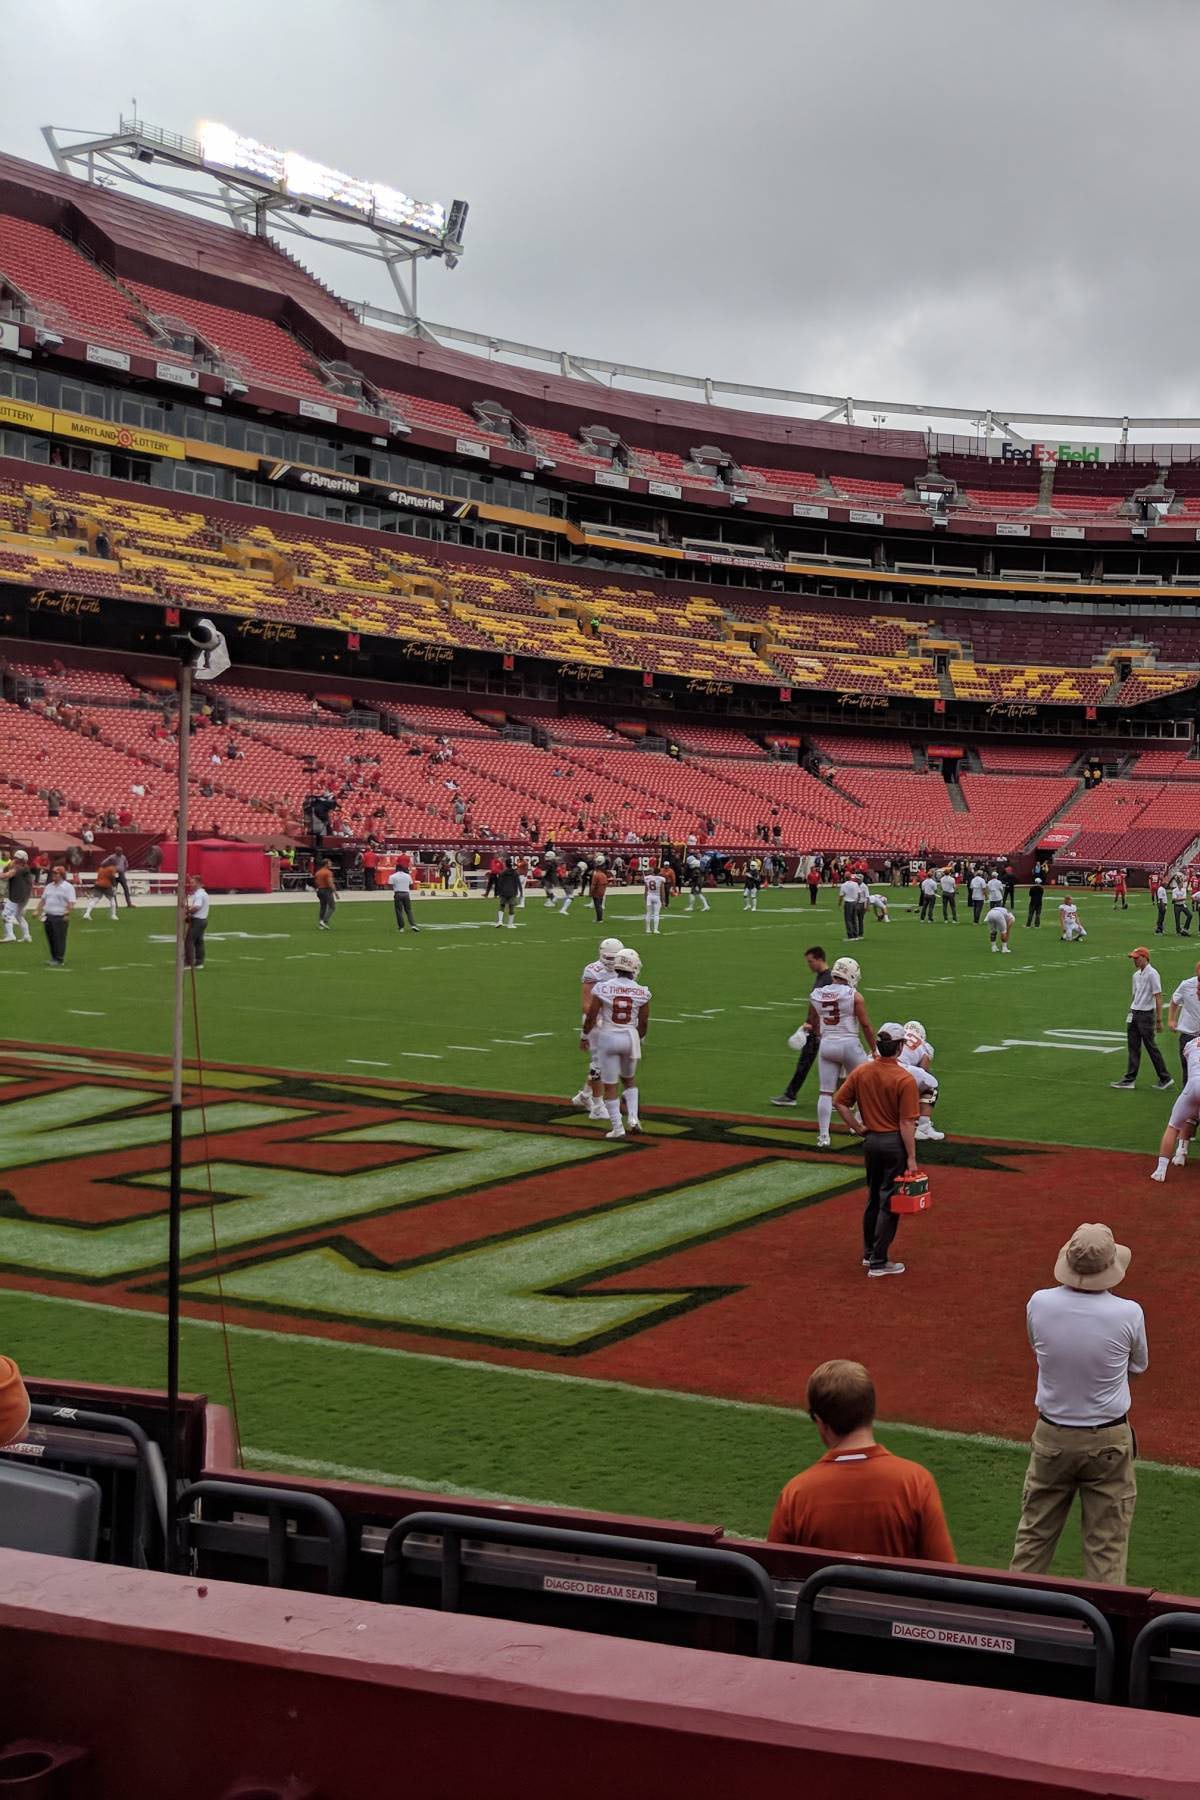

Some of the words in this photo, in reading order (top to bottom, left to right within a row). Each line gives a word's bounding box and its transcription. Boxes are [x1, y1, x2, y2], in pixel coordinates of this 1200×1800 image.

[0, 406, 35, 422] OTTERY
[71, 422, 116, 441] MARYLAND
[135, 438, 170, 452] LOTTERY
[1001, 442, 1100, 463] FedExField
[309, 472, 360, 494] Ameritel
[398, 491, 445, 513] Ameritel
[609, 986, 645, 996] THOMPSON
[612, 995, 633, 1024] 8
[821, 1000, 841, 1026] 3
[920, 1197, 926, 1208] G
[545, 1578, 585, 1593] DIAGEO
[586, 1583, 624, 1598] DREAM
[625, 1587, 656, 1602] SEATS
[893, 1624, 936, 1641] DIAGEO
[937, 1630, 978, 1647] DREAM
[979, 1635, 1013, 1651] SEATS
